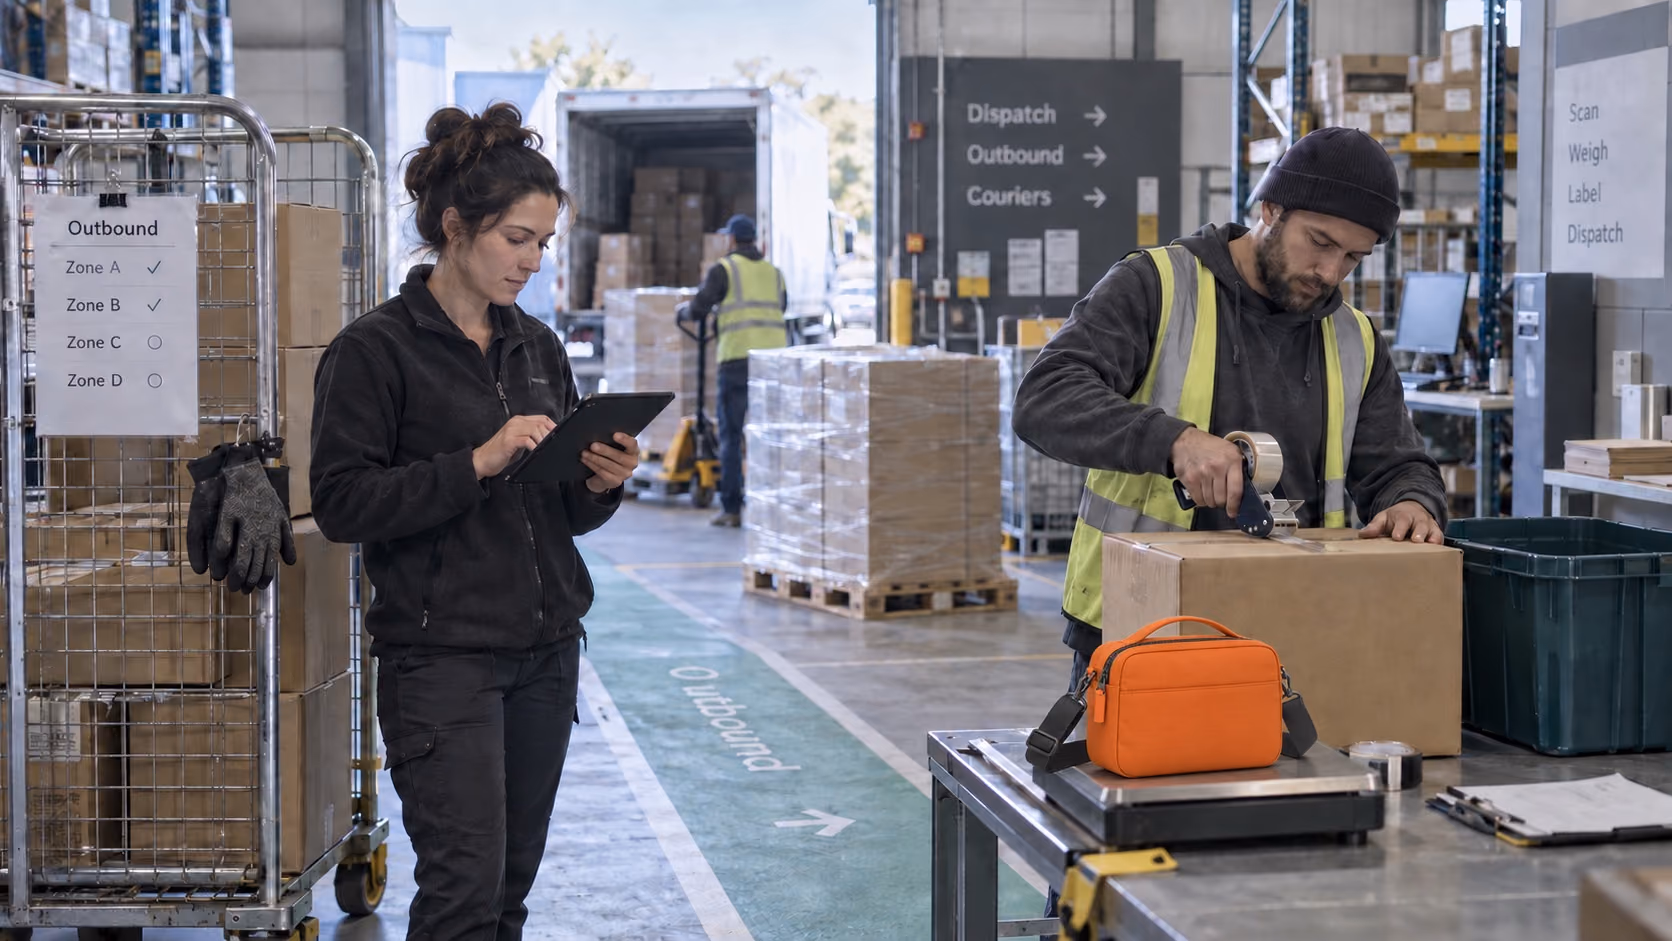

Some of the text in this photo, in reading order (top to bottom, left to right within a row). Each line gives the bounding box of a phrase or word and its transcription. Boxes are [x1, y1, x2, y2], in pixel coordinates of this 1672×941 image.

[967, 103, 1057, 127] Dispatch
[1569, 103, 1599, 122] Scan
[967, 144, 1064, 166] Outbound
[1569, 140, 1608, 166] Weigh
[967, 185, 1052, 206] Couriers
[1568, 181, 1602, 204] Label
[68, 220, 158, 236] Outbound
[1567, 221, 1624, 248] Dispatch
[66, 261, 121, 274] Zone A
[66, 298, 120, 312] Zone B
[67, 335, 121, 349] Zone C
[67, 373, 123, 387] Zone D
[669, 666, 801, 772] Outbound
